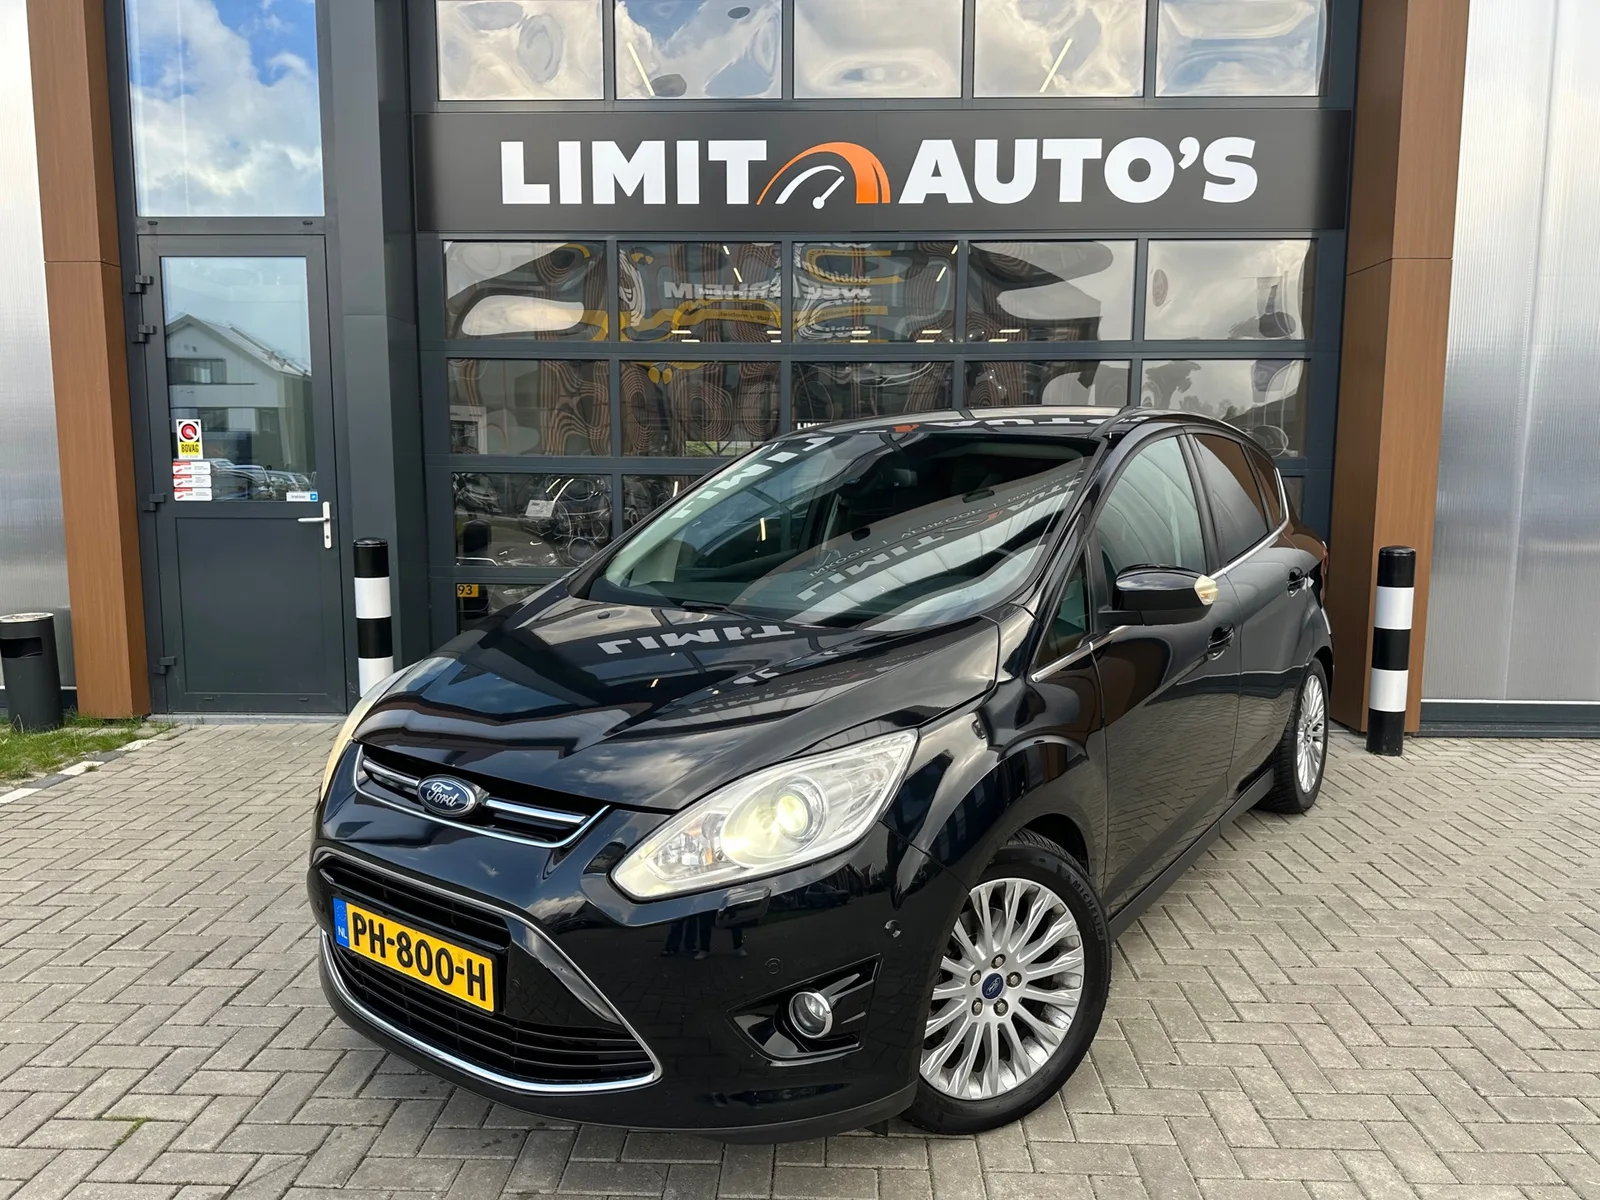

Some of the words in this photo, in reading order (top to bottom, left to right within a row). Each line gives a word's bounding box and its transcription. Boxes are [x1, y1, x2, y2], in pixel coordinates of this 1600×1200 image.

[500, 140, 768, 205] LIMIT
[897, 136, 1259, 205] AUTO'S
[180, 444, 200, 453] BOVAG
[457, 584, 473, 596] 93
[426, 782, 460, 808] Ford
[1071, 880, 1105, 937] MICHELIN
[337, 925, 348, 940] NL
[352, 911, 487, 1002] PH-800-H
